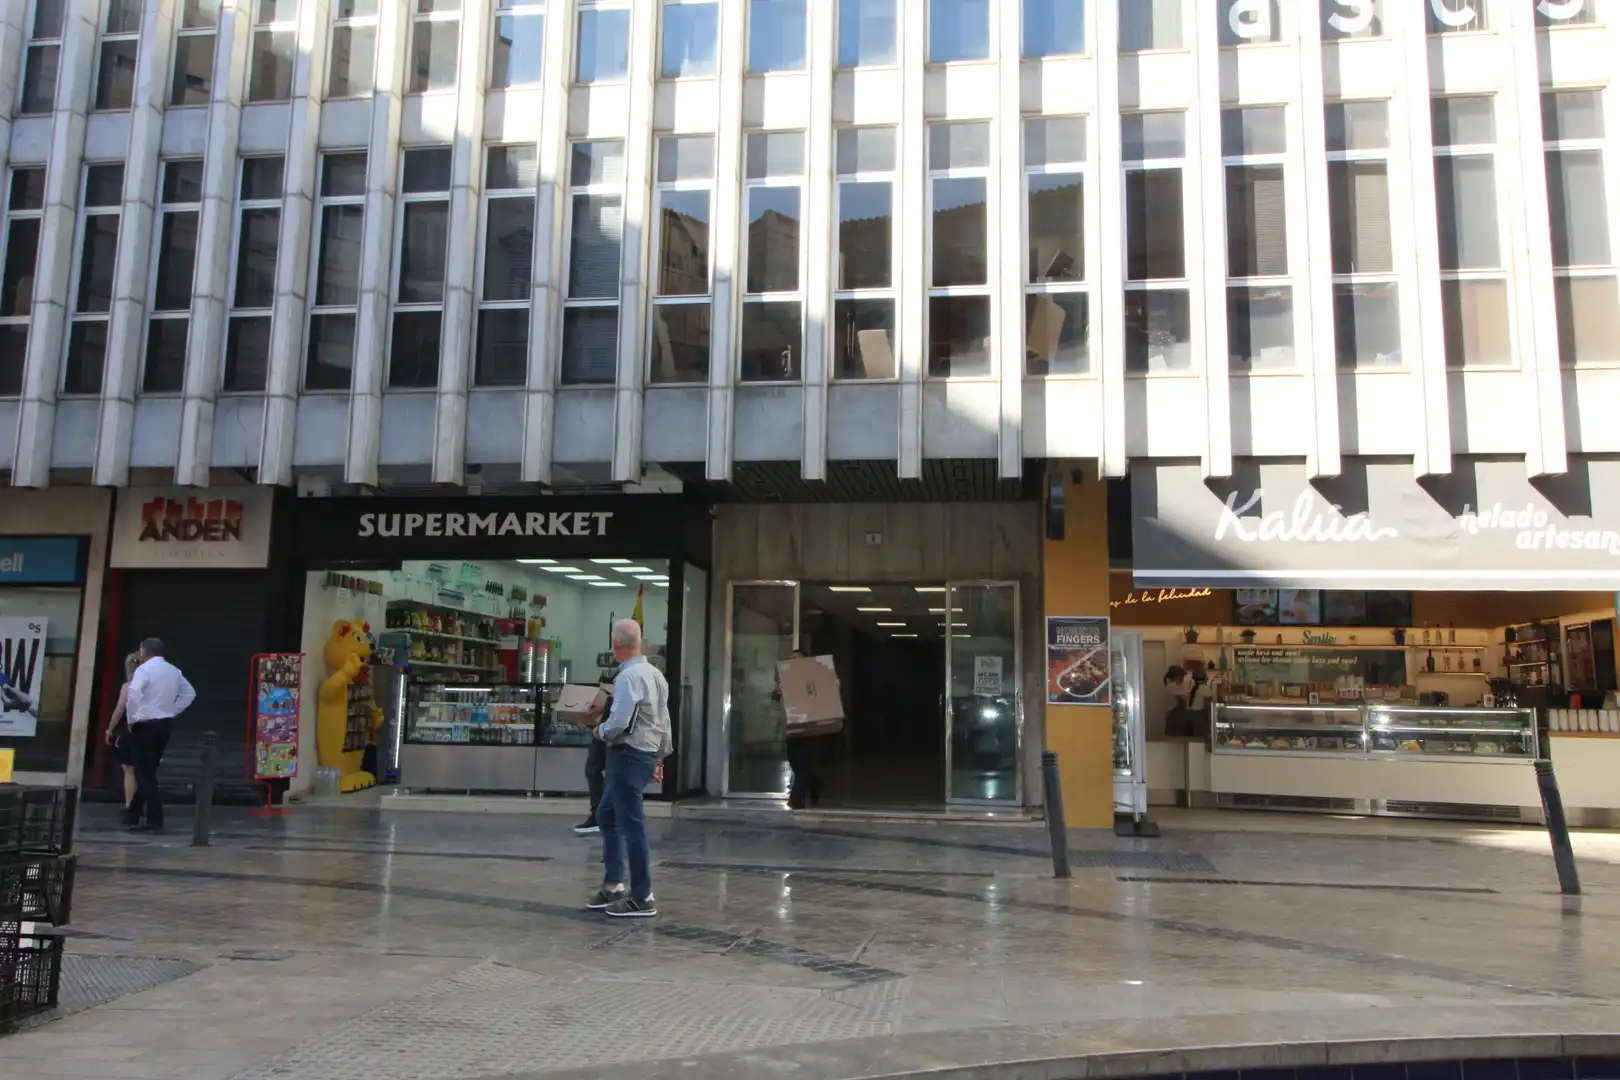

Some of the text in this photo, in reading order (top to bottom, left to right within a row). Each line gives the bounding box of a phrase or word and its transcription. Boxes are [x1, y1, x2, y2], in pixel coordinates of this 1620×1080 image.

[358, 511, 614, 538] SUPERMARKET
[1515, 523, 1620, 555] artesan
[1124, 592, 1139, 604] de
[1141, 590, 1155, 602] la
[1056, 635, 1100, 644] FINGERS
